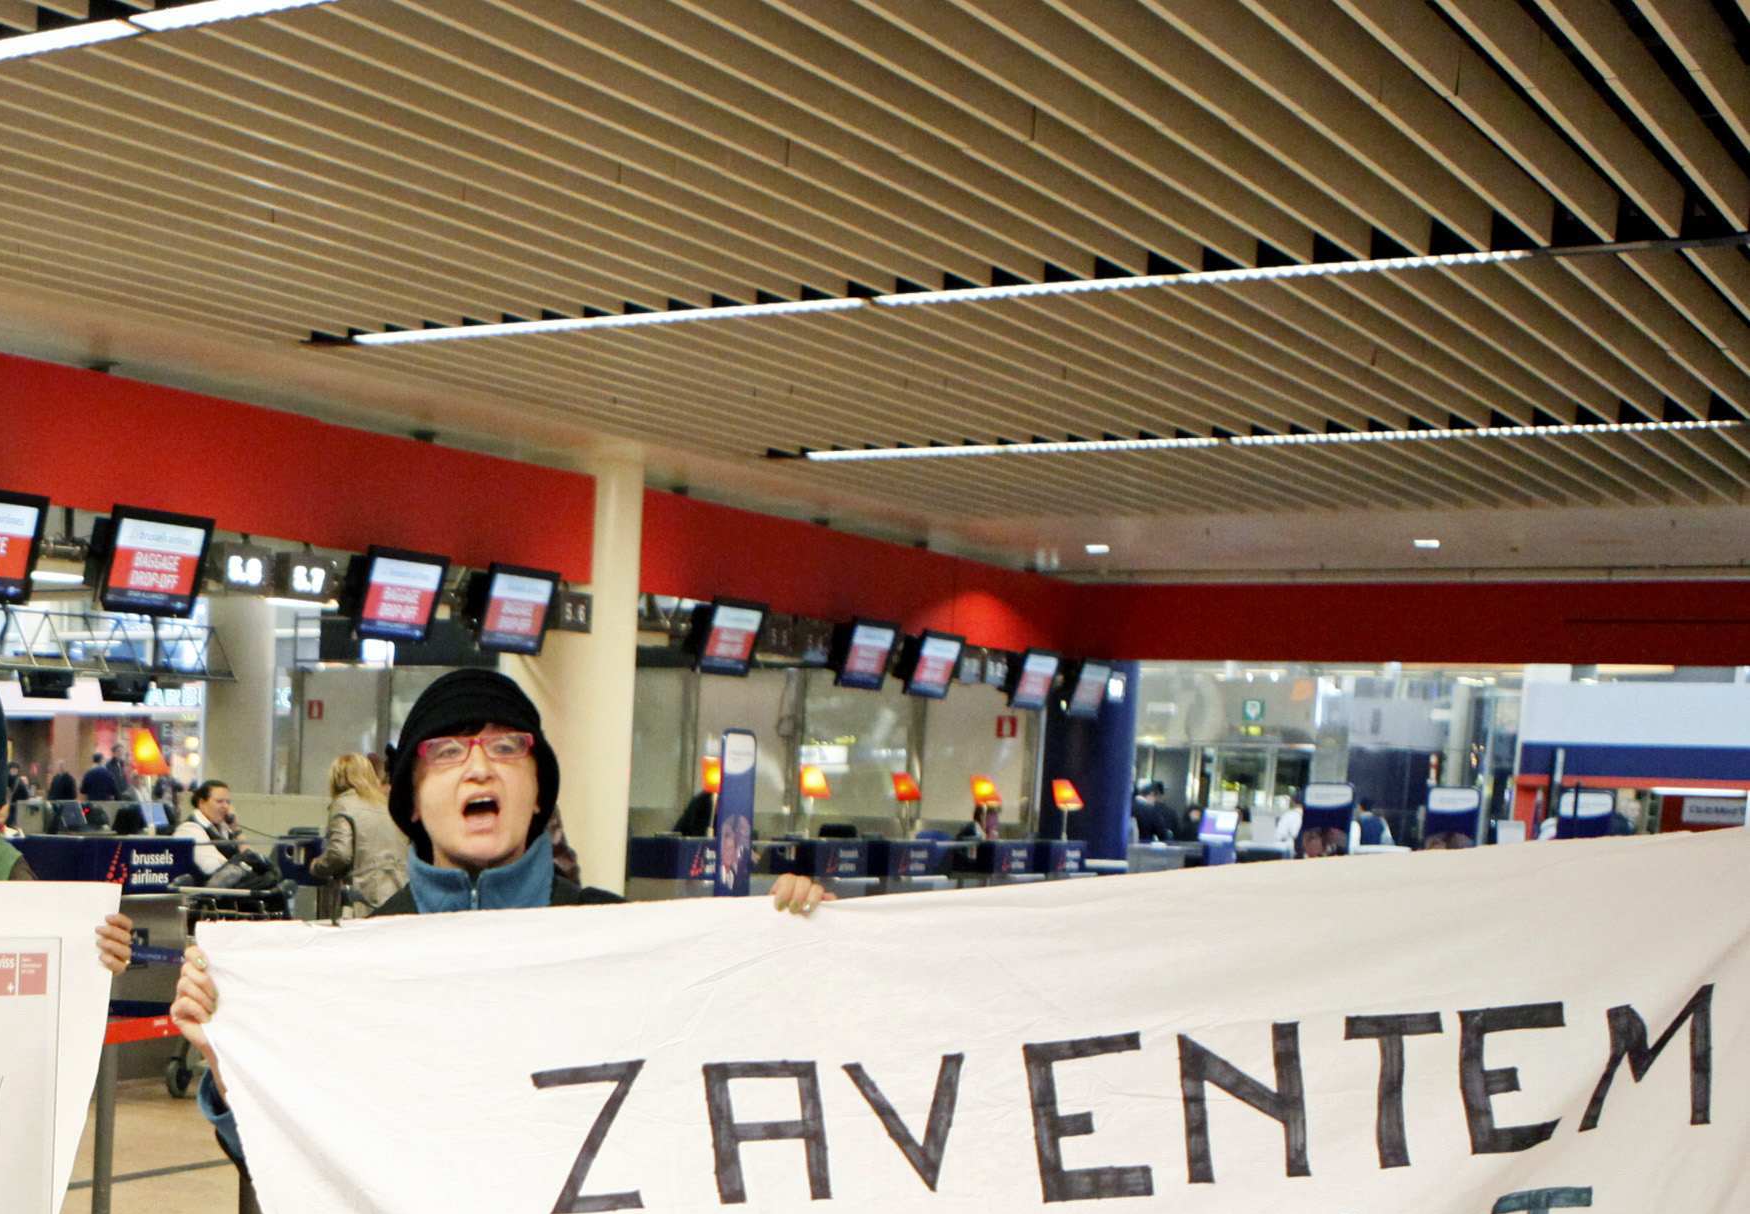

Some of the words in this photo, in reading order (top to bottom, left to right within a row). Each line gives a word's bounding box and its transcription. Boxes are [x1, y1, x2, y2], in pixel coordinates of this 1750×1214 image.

[130, 848, 174, 865] brussels
[130, 872, 170, 885] airlines
[530, 983, 1716, 1214] ZAVENTEM
